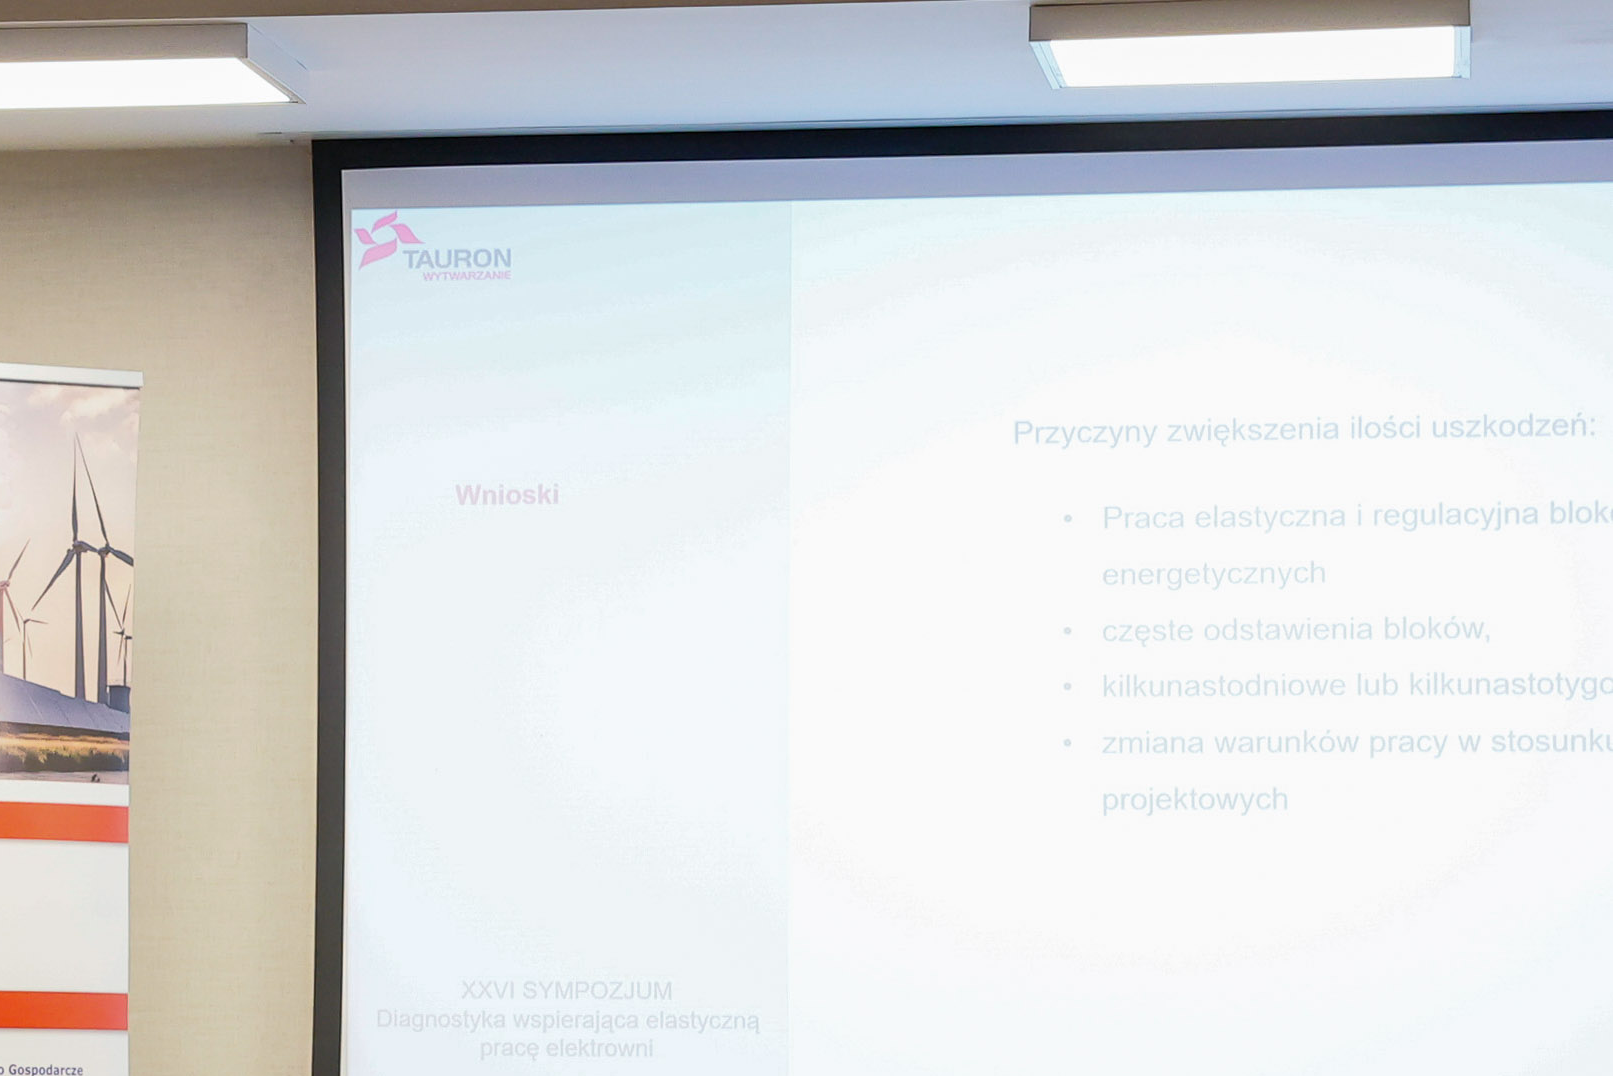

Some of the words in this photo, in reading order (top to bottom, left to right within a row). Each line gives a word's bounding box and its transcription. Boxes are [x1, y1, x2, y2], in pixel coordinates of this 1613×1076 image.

[403, 248, 512, 269] TAURON
[423, 270, 512, 282] WYTWARZANIE
[1014, 420, 1158, 449] Przyczyny
[1167, 417, 1340, 447] zwiększenia
[1350, 415, 1422, 441] ilości
[1432, 412, 1597, 439] uszkodzeń:
[455, 484, 560, 506] Wnioski
[1104, 505, 1185, 530] Praca
[1195, 503, 1347, 531] elastyczna
[1357, 503, 1363, 526] i
[1373, 501, 1540, 532] regulacyjna
[1550, 499, 1613, 525] blok
[1102, 561, 1326, 591] energetycznych
[1102, 618, 1194, 647] częste
[1203, 616, 1374, 642] odstawienia
[1384, 615, 1492, 644] bloków,
[1102, 673, 1347, 699] kilkunastodniowe
[1357, 673, 1399, 697] lub
[1102, 730, 1205, 755] zmiana
[1214, 728, 1360, 754] warunków
[1369, 731, 1448, 759] pracy
[1458, 734, 1482, 754] w
[1102, 786, 1289, 816] projektowych
[461, 980, 515, 1001] XXVI
[523, 980, 673, 1001] SYMPOZJUM
[377, 1008, 506, 1034] Diagnostyka
[513, 1008, 639, 1035] wspierająca
[646, 1010, 761, 1035] elastyczną
[480, 1041, 540, 1061] pracę
[546, 1038, 654, 1058] elektrowni
